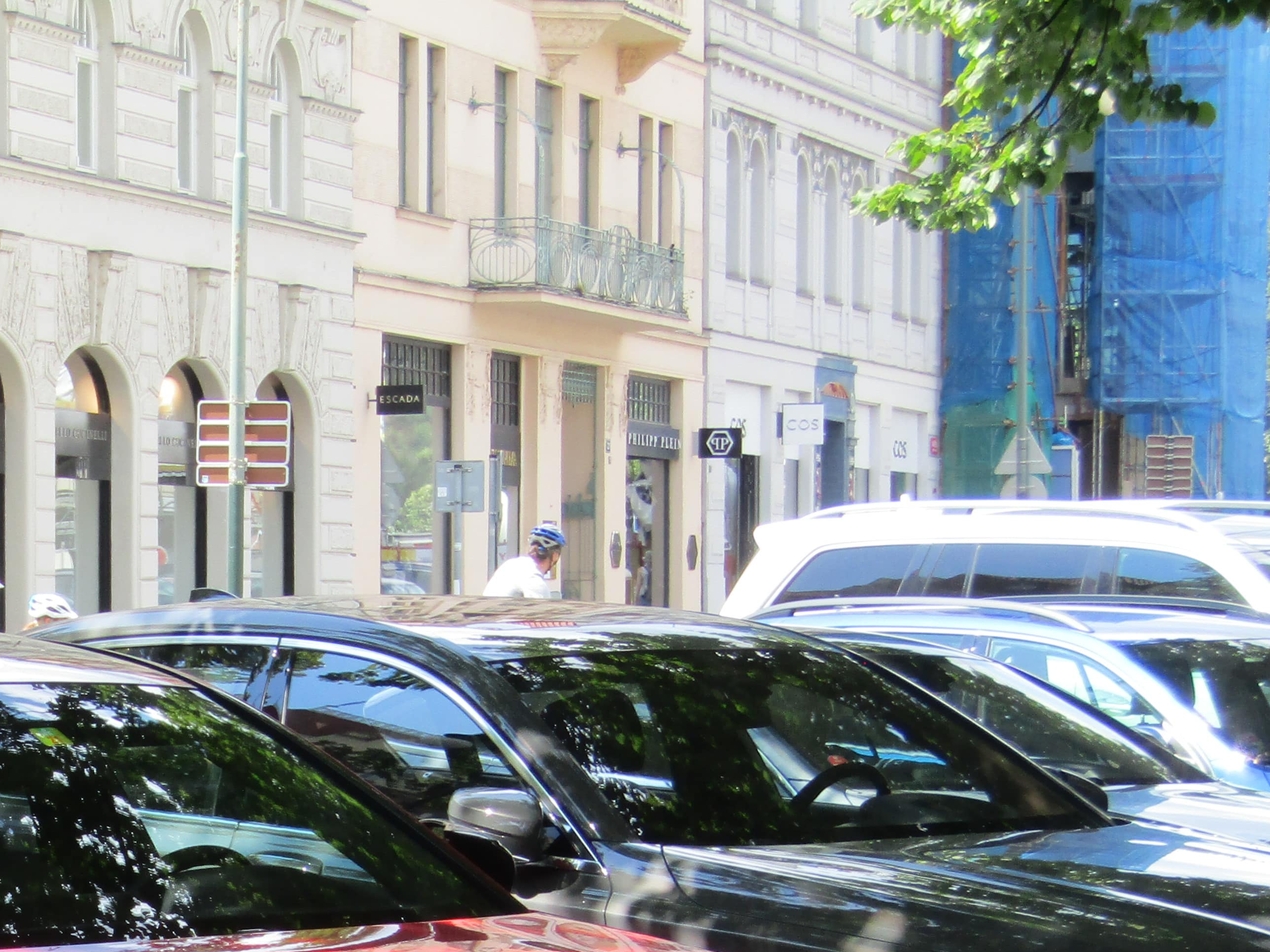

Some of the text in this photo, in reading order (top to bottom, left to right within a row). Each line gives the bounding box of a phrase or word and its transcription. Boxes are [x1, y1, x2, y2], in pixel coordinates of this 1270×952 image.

[379, 394, 420, 404] ESCADA
[786, 419, 819, 431] COS
[628, 432, 658, 448] PHILIPP
